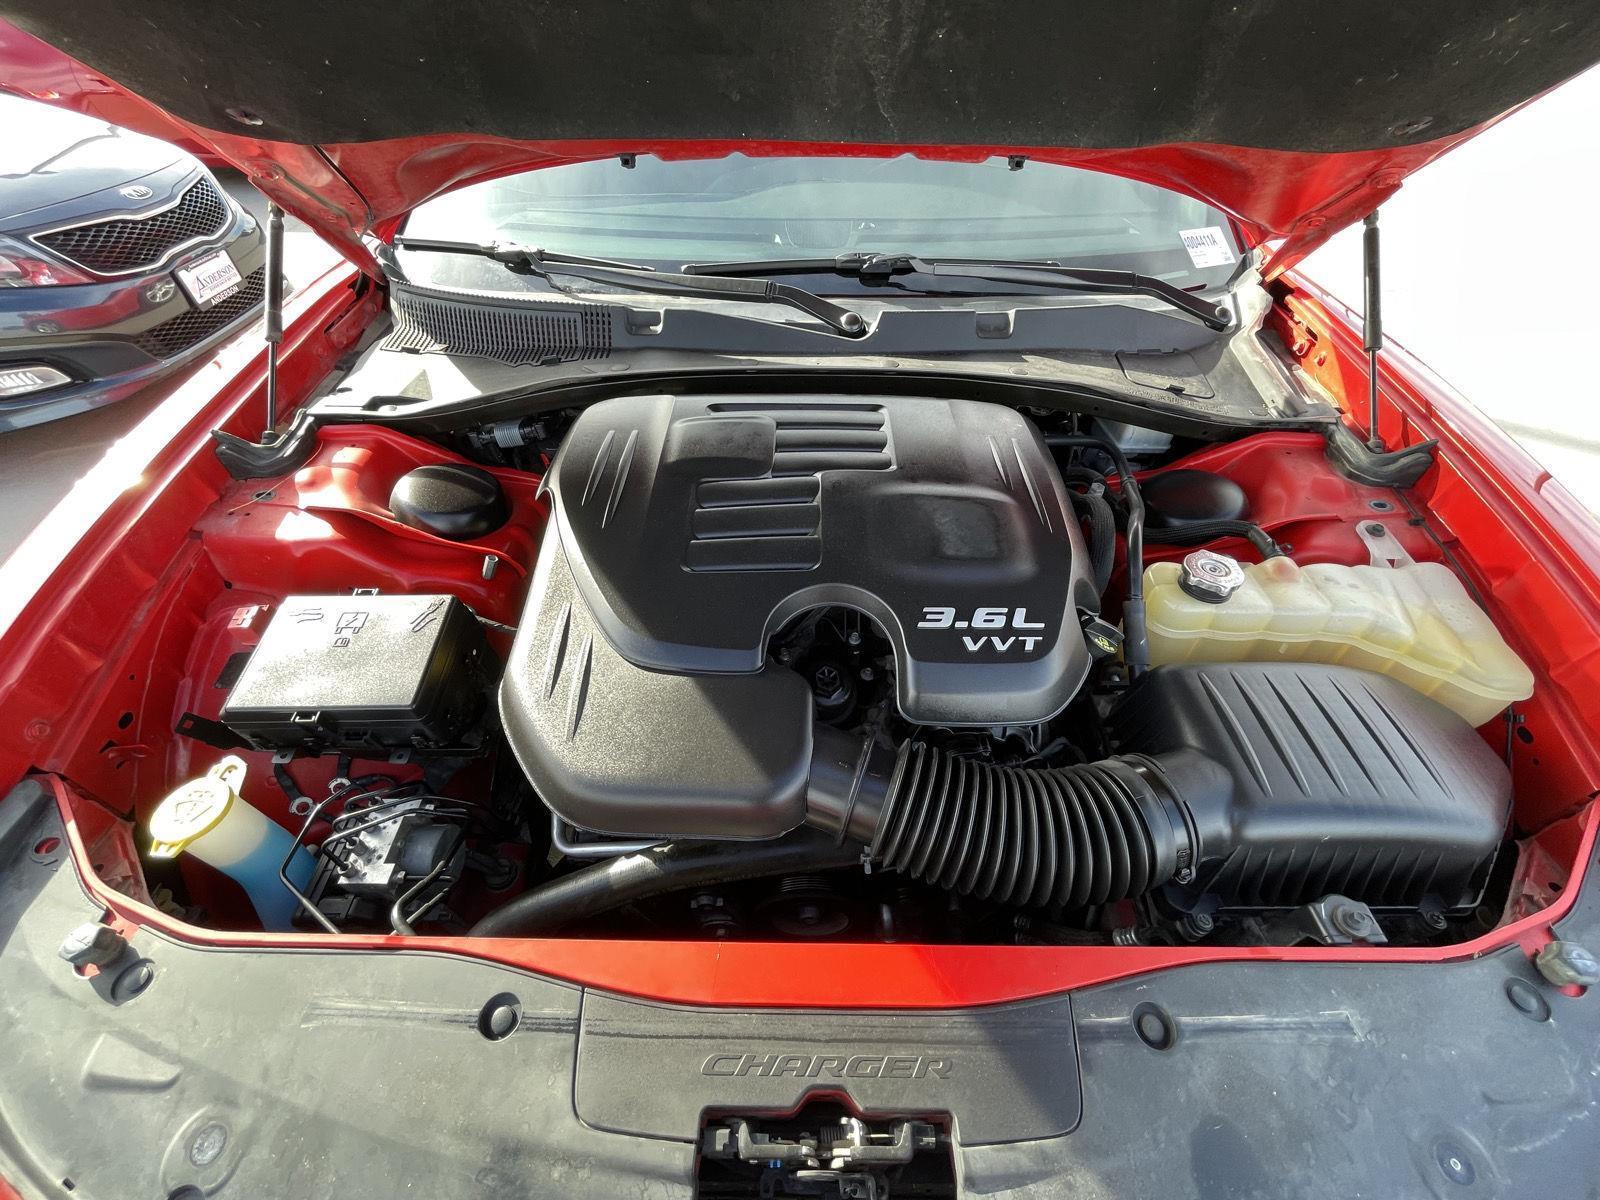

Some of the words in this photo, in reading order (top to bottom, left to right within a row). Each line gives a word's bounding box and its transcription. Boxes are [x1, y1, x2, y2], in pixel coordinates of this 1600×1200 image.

[196, 264, 235, 298] ANDERSON
[210, 285, 240, 306] ANDERSON
[917, 606, 1046, 630] 3.6L
[962, 636, 1043, 652] VVT
[701, 1053, 953, 1079] CHARGER
